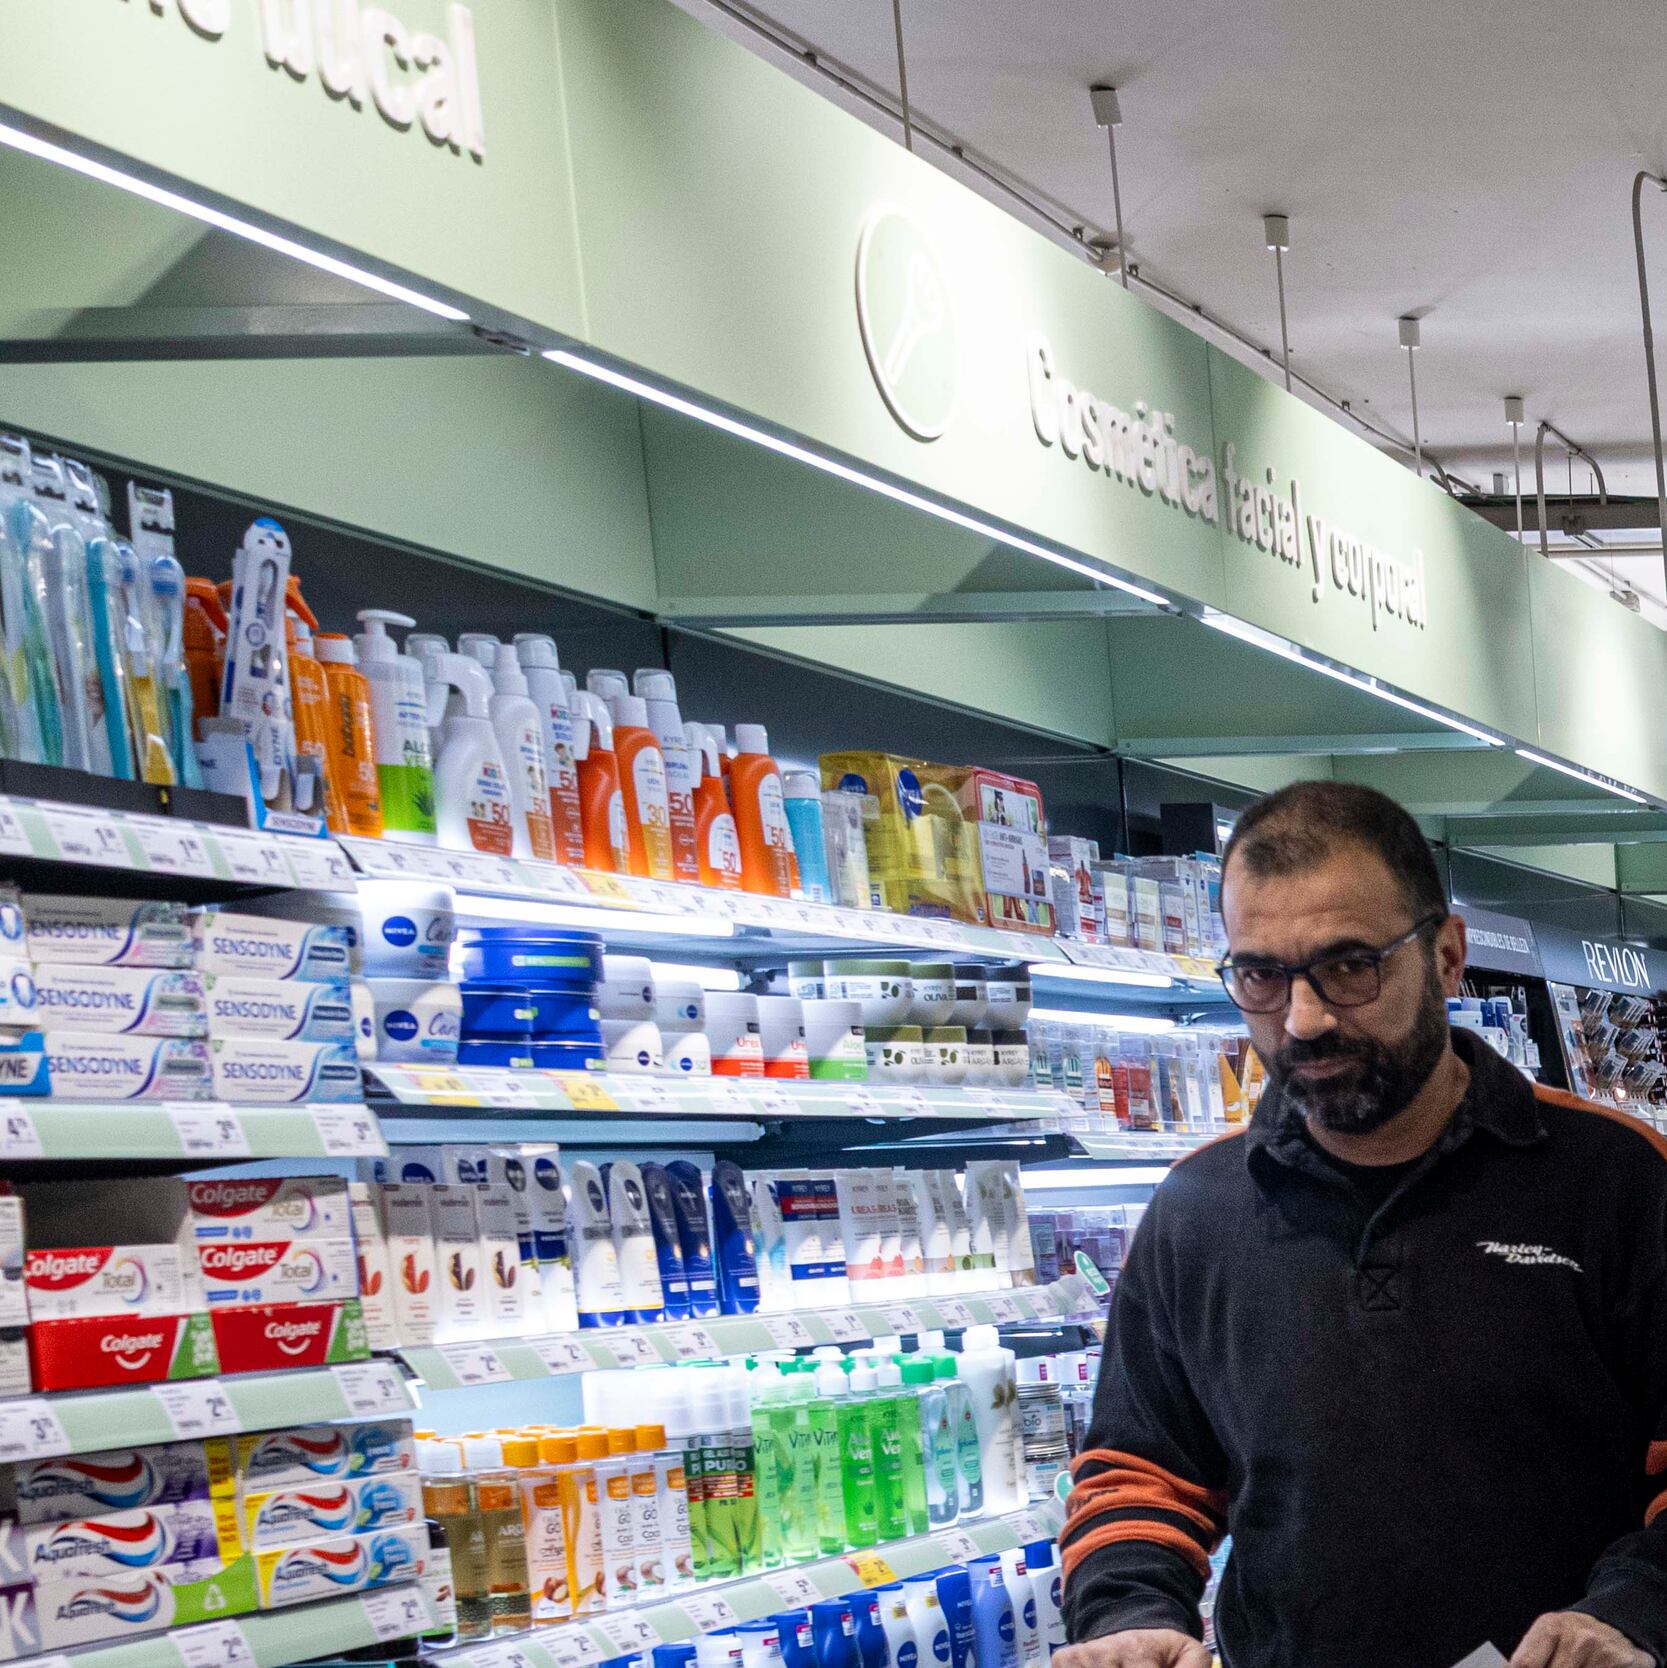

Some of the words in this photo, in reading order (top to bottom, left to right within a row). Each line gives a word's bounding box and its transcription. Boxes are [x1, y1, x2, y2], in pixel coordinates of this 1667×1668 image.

[1026, 330, 1219, 528] Cosmética
[1223, 441, 1303, 570] facial
[1308, 513, 1326, 604] y
[1330, 528, 1427, 632] corporal
[212, 935, 295, 961] SENSODYNE
[1581, 940, 1652, 990] REVLON
[37, 986, 136, 1011] SENSODYNE
[215, 999, 298, 1021] SENSODYNE
[47, 1055, 143, 1078] SENSODYNE
[222, 1060, 305, 1082] SENSODYNE
[189, 1181, 268, 1206] Colgate
[200, 1245, 279, 1270] Colgate
[101, 1269, 136, 1290] Total
[280, 1260, 314, 1283] Total
[264, 1320, 321, 1341] Colgate
[101, 1332, 164, 1354] Colgate
[35, 1536, 112, 1565] Aquafresh
